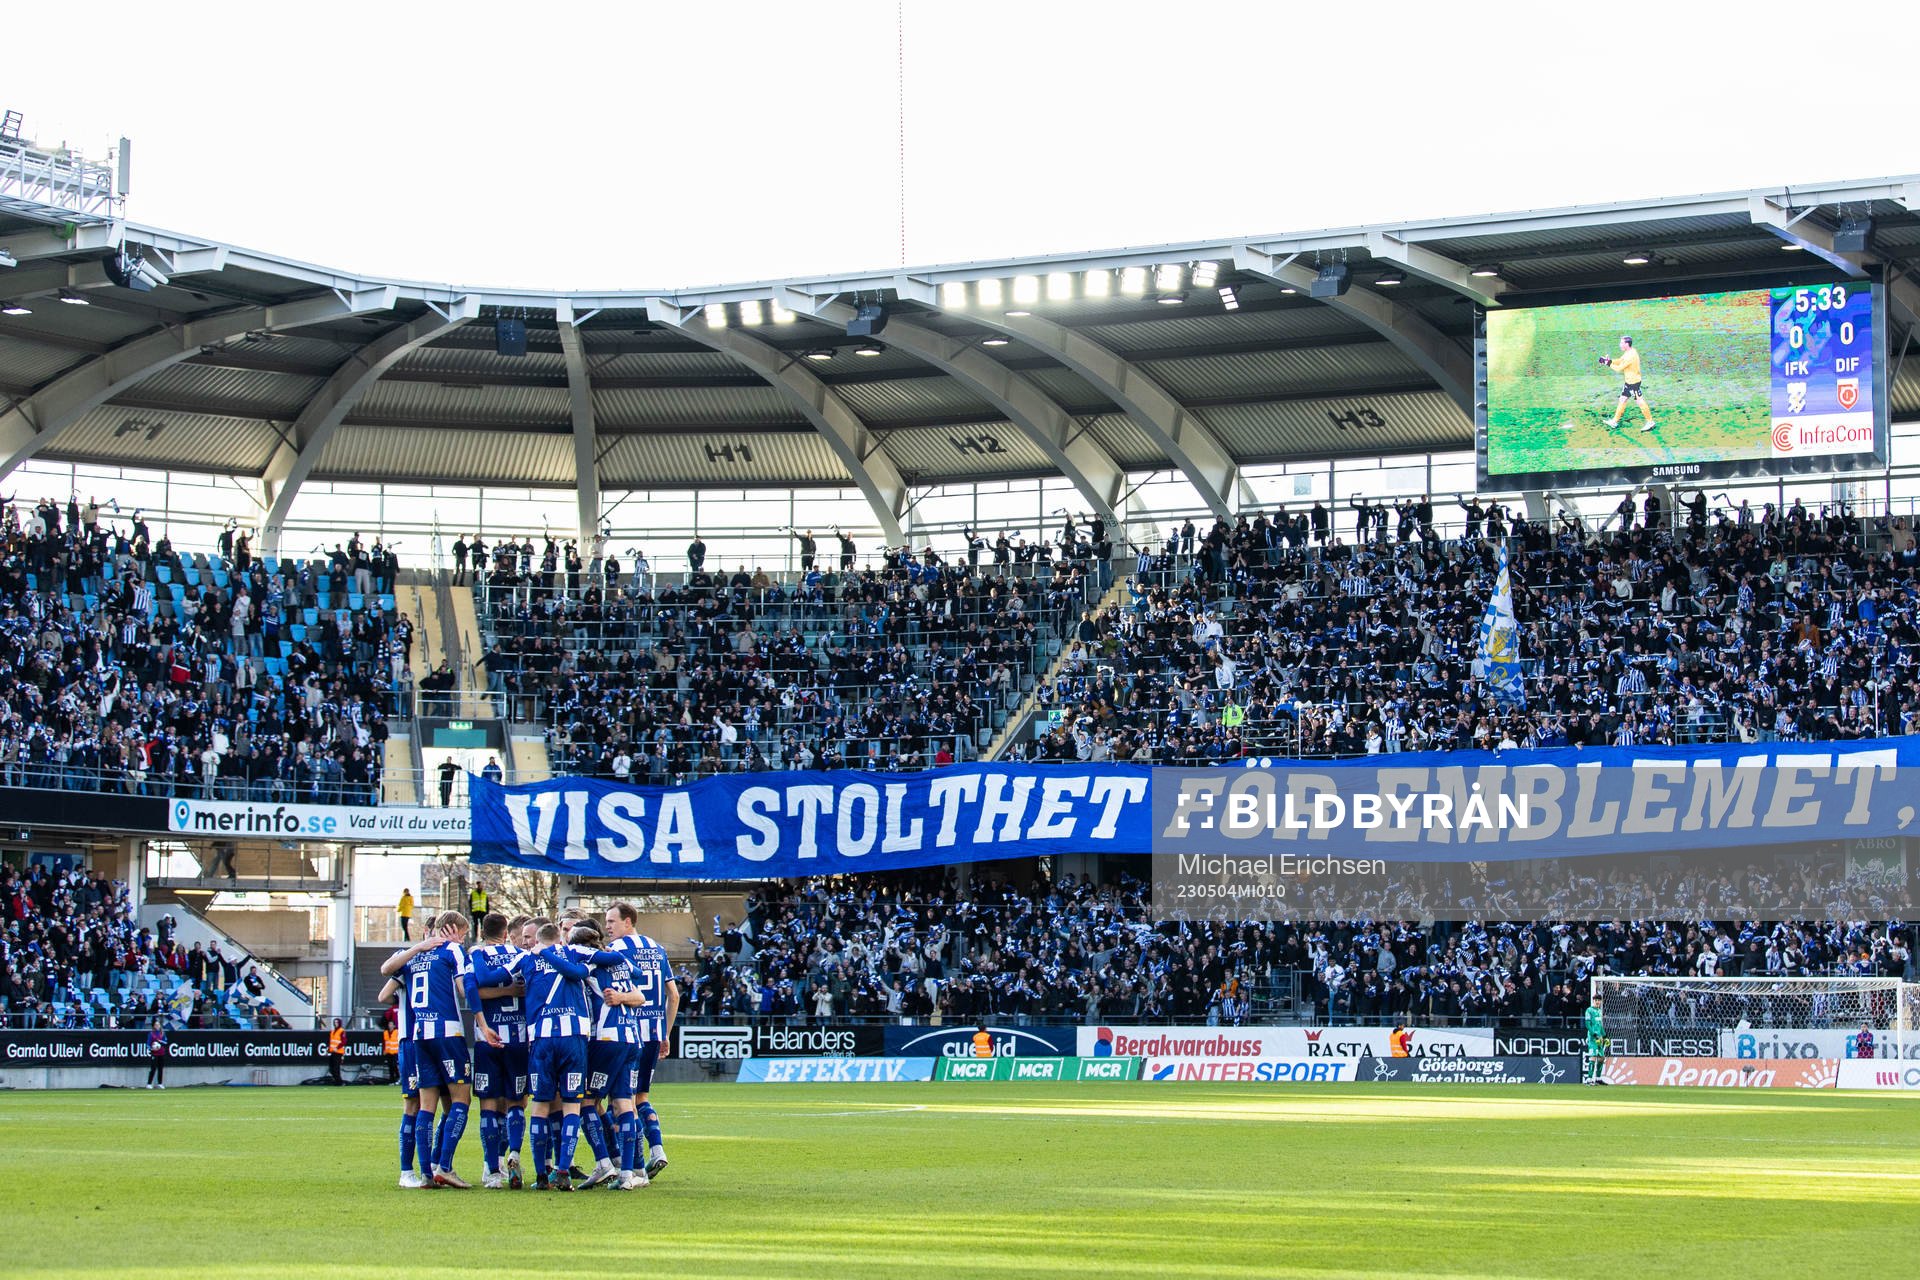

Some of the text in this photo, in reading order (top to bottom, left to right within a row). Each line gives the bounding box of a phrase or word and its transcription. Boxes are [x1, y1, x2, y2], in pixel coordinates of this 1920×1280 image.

[1795, 287, 1846, 312] 5:33
[1790, 322, 1854, 349] 0 0
[1785, 358, 1859, 376] IFK DIF
[1328, 409, 1385, 430] H3
[950, 435, 1007, 455] H2
[1800, 425, 1873, 446] InfraCom
[705, 443, 752, 462] H1
[1652, 465, 1701, 477] SAMSUNG
[195, 806, 337, 833] merinfo.se
[350, 814, 375, 829] Vad
[380, 813, 404, 830] vill
[408, 815, 429, 830] du
[504, 791, 704, 863] VISA
[735, 773, 1149, 861] STOLTHET
[411, 971, 429, 1009] 8
[679, 1026, 753, 1059] Peekab
[757, 1026, 856, 1050] Helanders
[1115, 1034, 1263, 1057] Bergkvarabuss
[1496, 1038, 1714, 1057] NORDIC ELLNESS
[7, 1042, 84, 1058] Gamla Ullevi
[89, 1042, 152, 1058] Gamla Ulle
[168, 1042, 239, 1058] Gamla Ullevi
[244, 1042, 280, 1058] Gamla
[282, 1042, 313, 1058] Ullevi
[353, 1042, 382, 1058] Ullevi
[1308, 1042, 1374, 1057] RASTA
[951, 1063, 989, 1078] MCR
[1017, 1063, 1055, 1078] MCR
[1084, 1063, 1122, 1078] MCR
[1176, 1061, 1347, 1082] INTERSPORT
[1418, 1058, 1505, 1077] Göteborgs
[1657, 1059, 1777, 1087] Renova
[1411, 1071, 1527, 1084] Metallpartier
